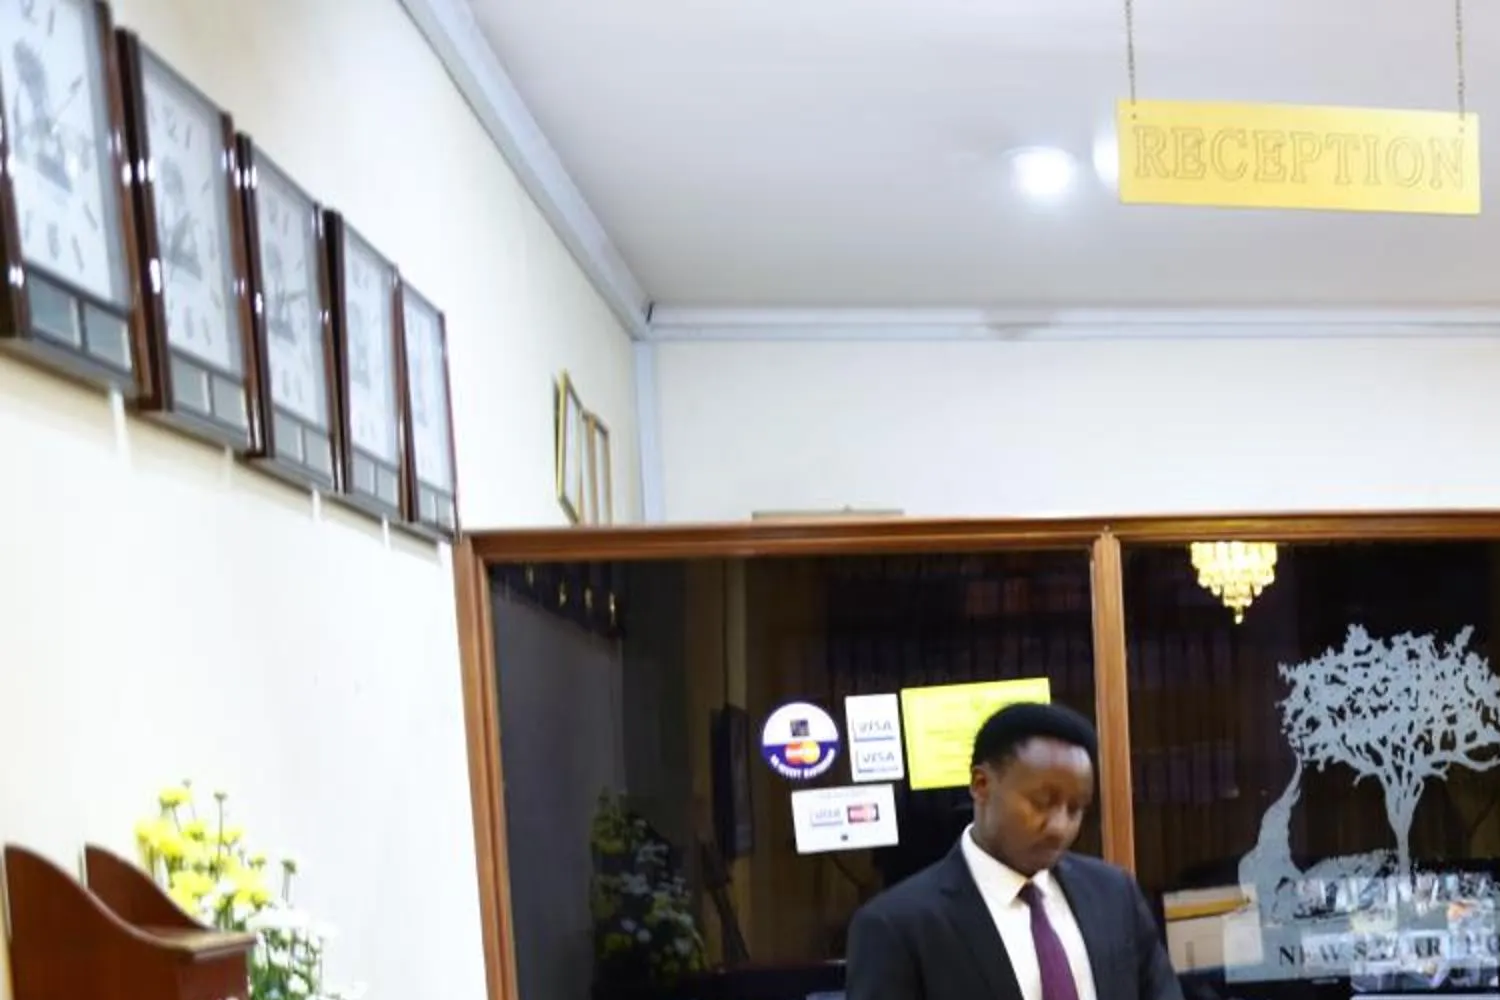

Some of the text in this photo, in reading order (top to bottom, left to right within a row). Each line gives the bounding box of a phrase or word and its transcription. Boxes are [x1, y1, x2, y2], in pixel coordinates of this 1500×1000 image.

[1132, 124, 1465, 190] RECEPTION
[857, 719, 893, 733] VISA
[862, 751, 895, 763] VISA
[1353, 935, 1455, 961] SARI
